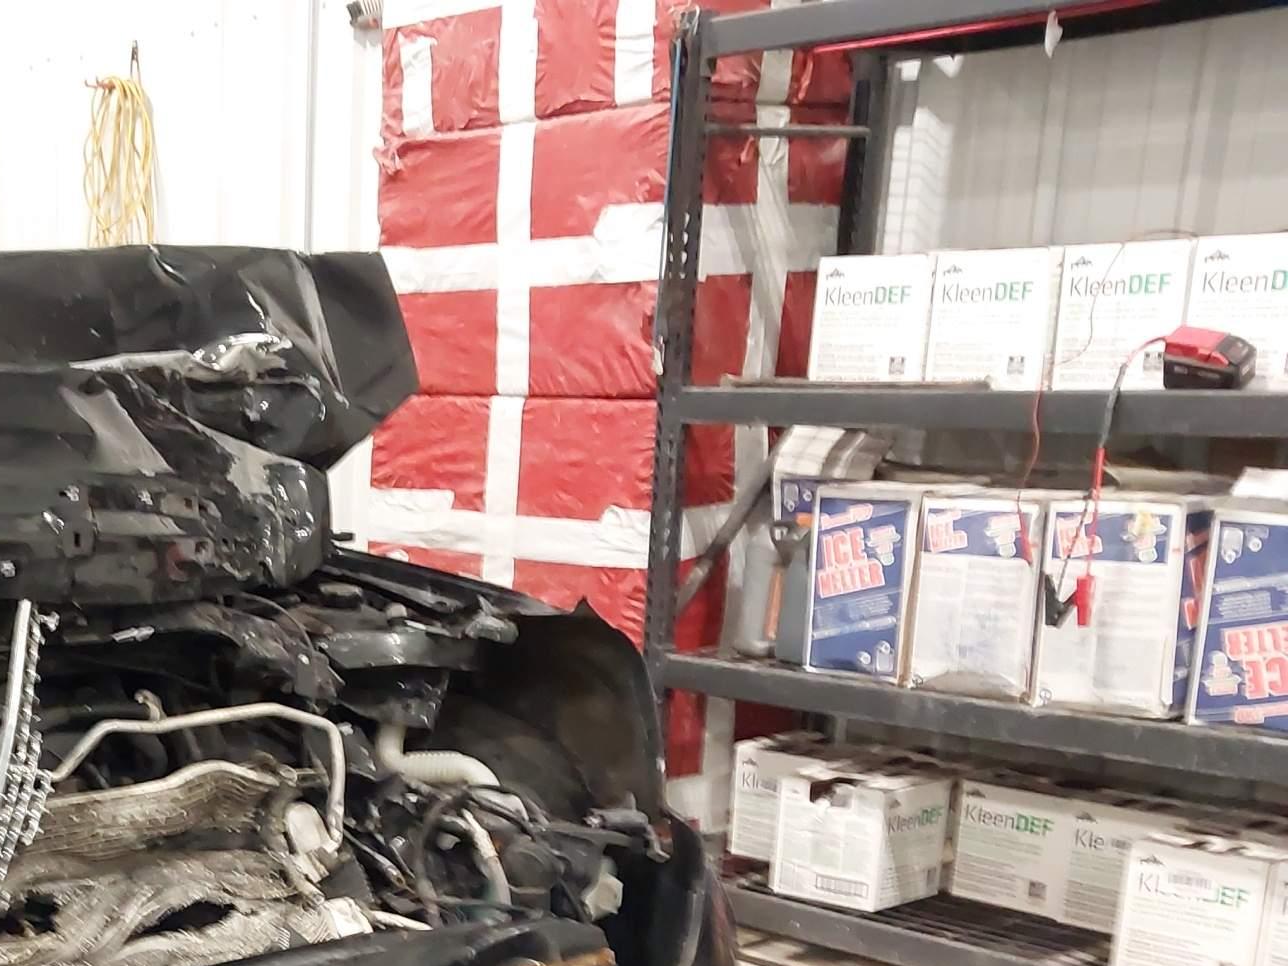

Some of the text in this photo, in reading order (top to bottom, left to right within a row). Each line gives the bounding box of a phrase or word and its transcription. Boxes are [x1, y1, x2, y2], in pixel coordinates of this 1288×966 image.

[824, 285, 912, 307] KleenDEF
[942, 281, 1034, 304] KleenDEF
[1069, 272, 1173, 298] KleenDEF
[823, 527, 867, 569] ICE
[964, 803, 1055, 836] KleenDEF
